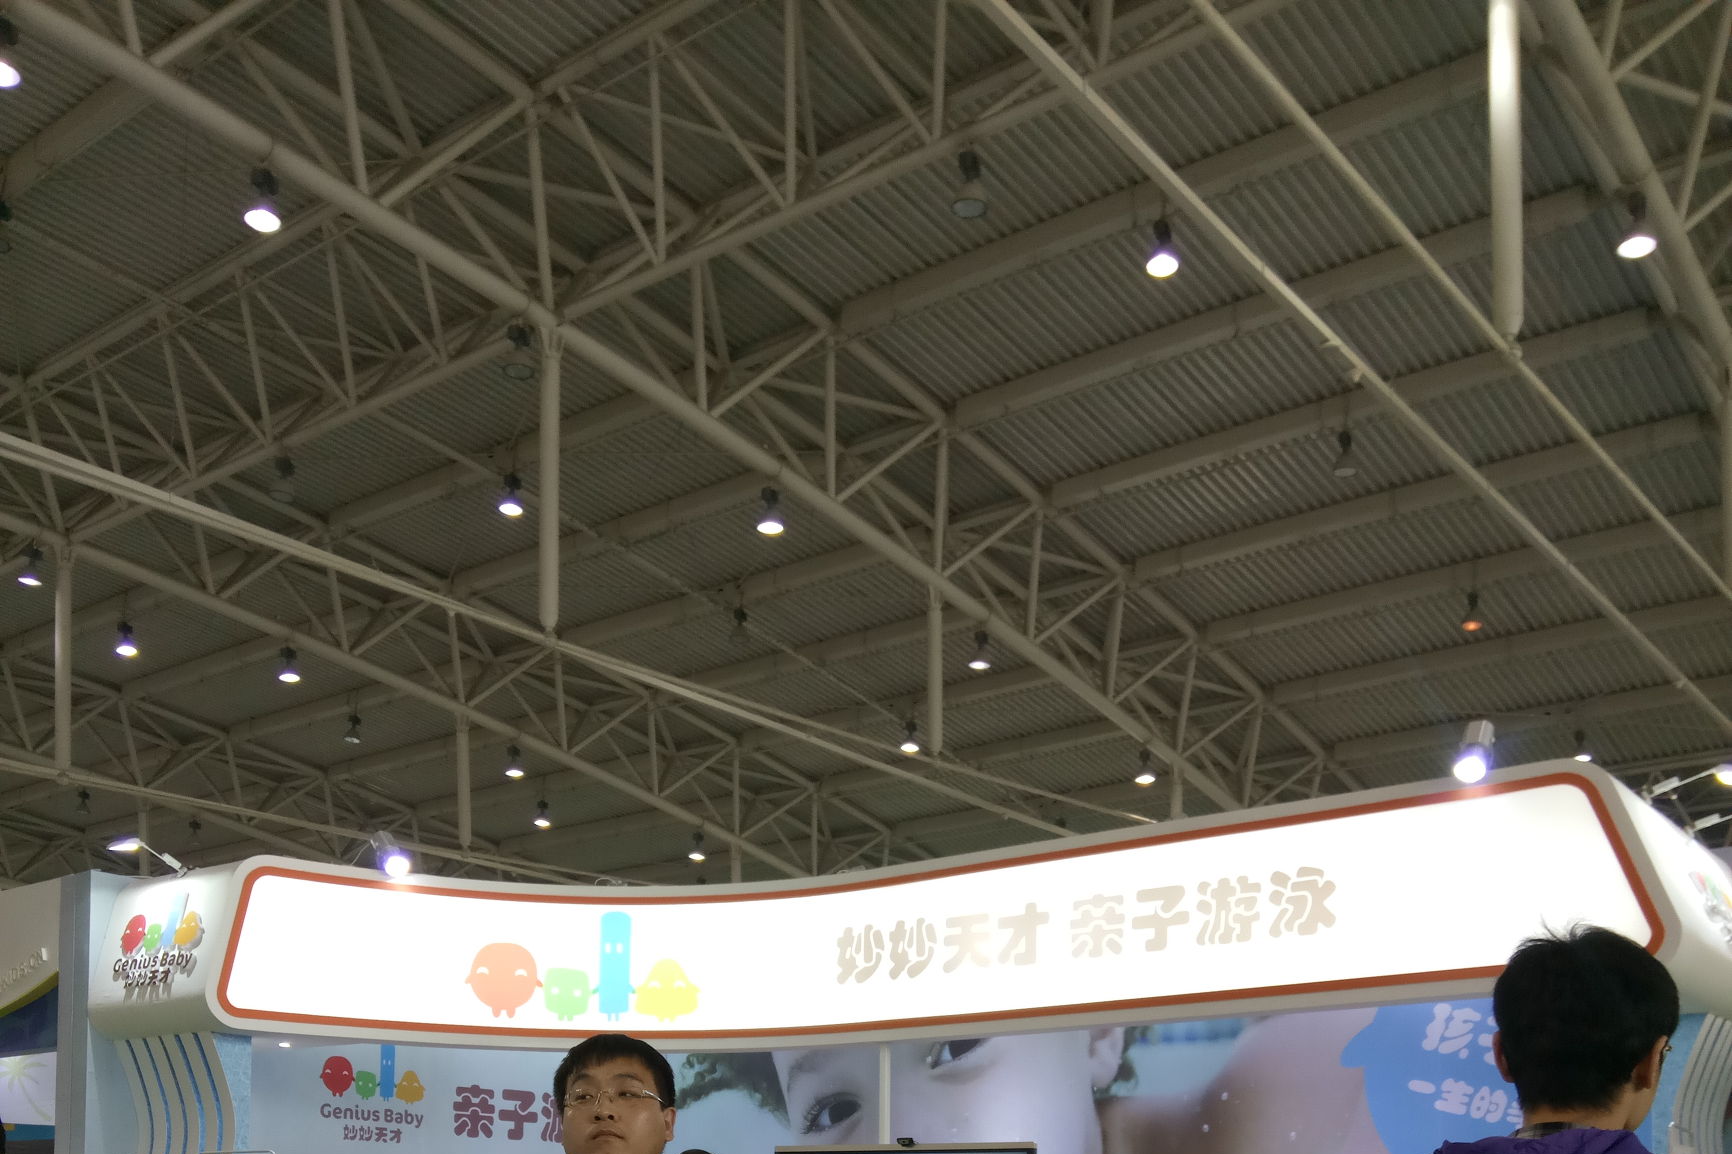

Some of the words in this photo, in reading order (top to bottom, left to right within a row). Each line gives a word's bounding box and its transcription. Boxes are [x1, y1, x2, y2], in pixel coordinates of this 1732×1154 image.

[836, 901, 1051, 985] 妙妙天才
[1069, 866, 1337, 959] 亲子游泳
[113, 954, 159, 973] Genius
[159, 950, 193, 969] Baby
[124, 967, 172, 989] 妙妙天才
[319, 1102, 381, 1122] Genius
[383, 1107, 425, 1129] Baby
[342, 1123, 403, 1144] 妙妙天才
